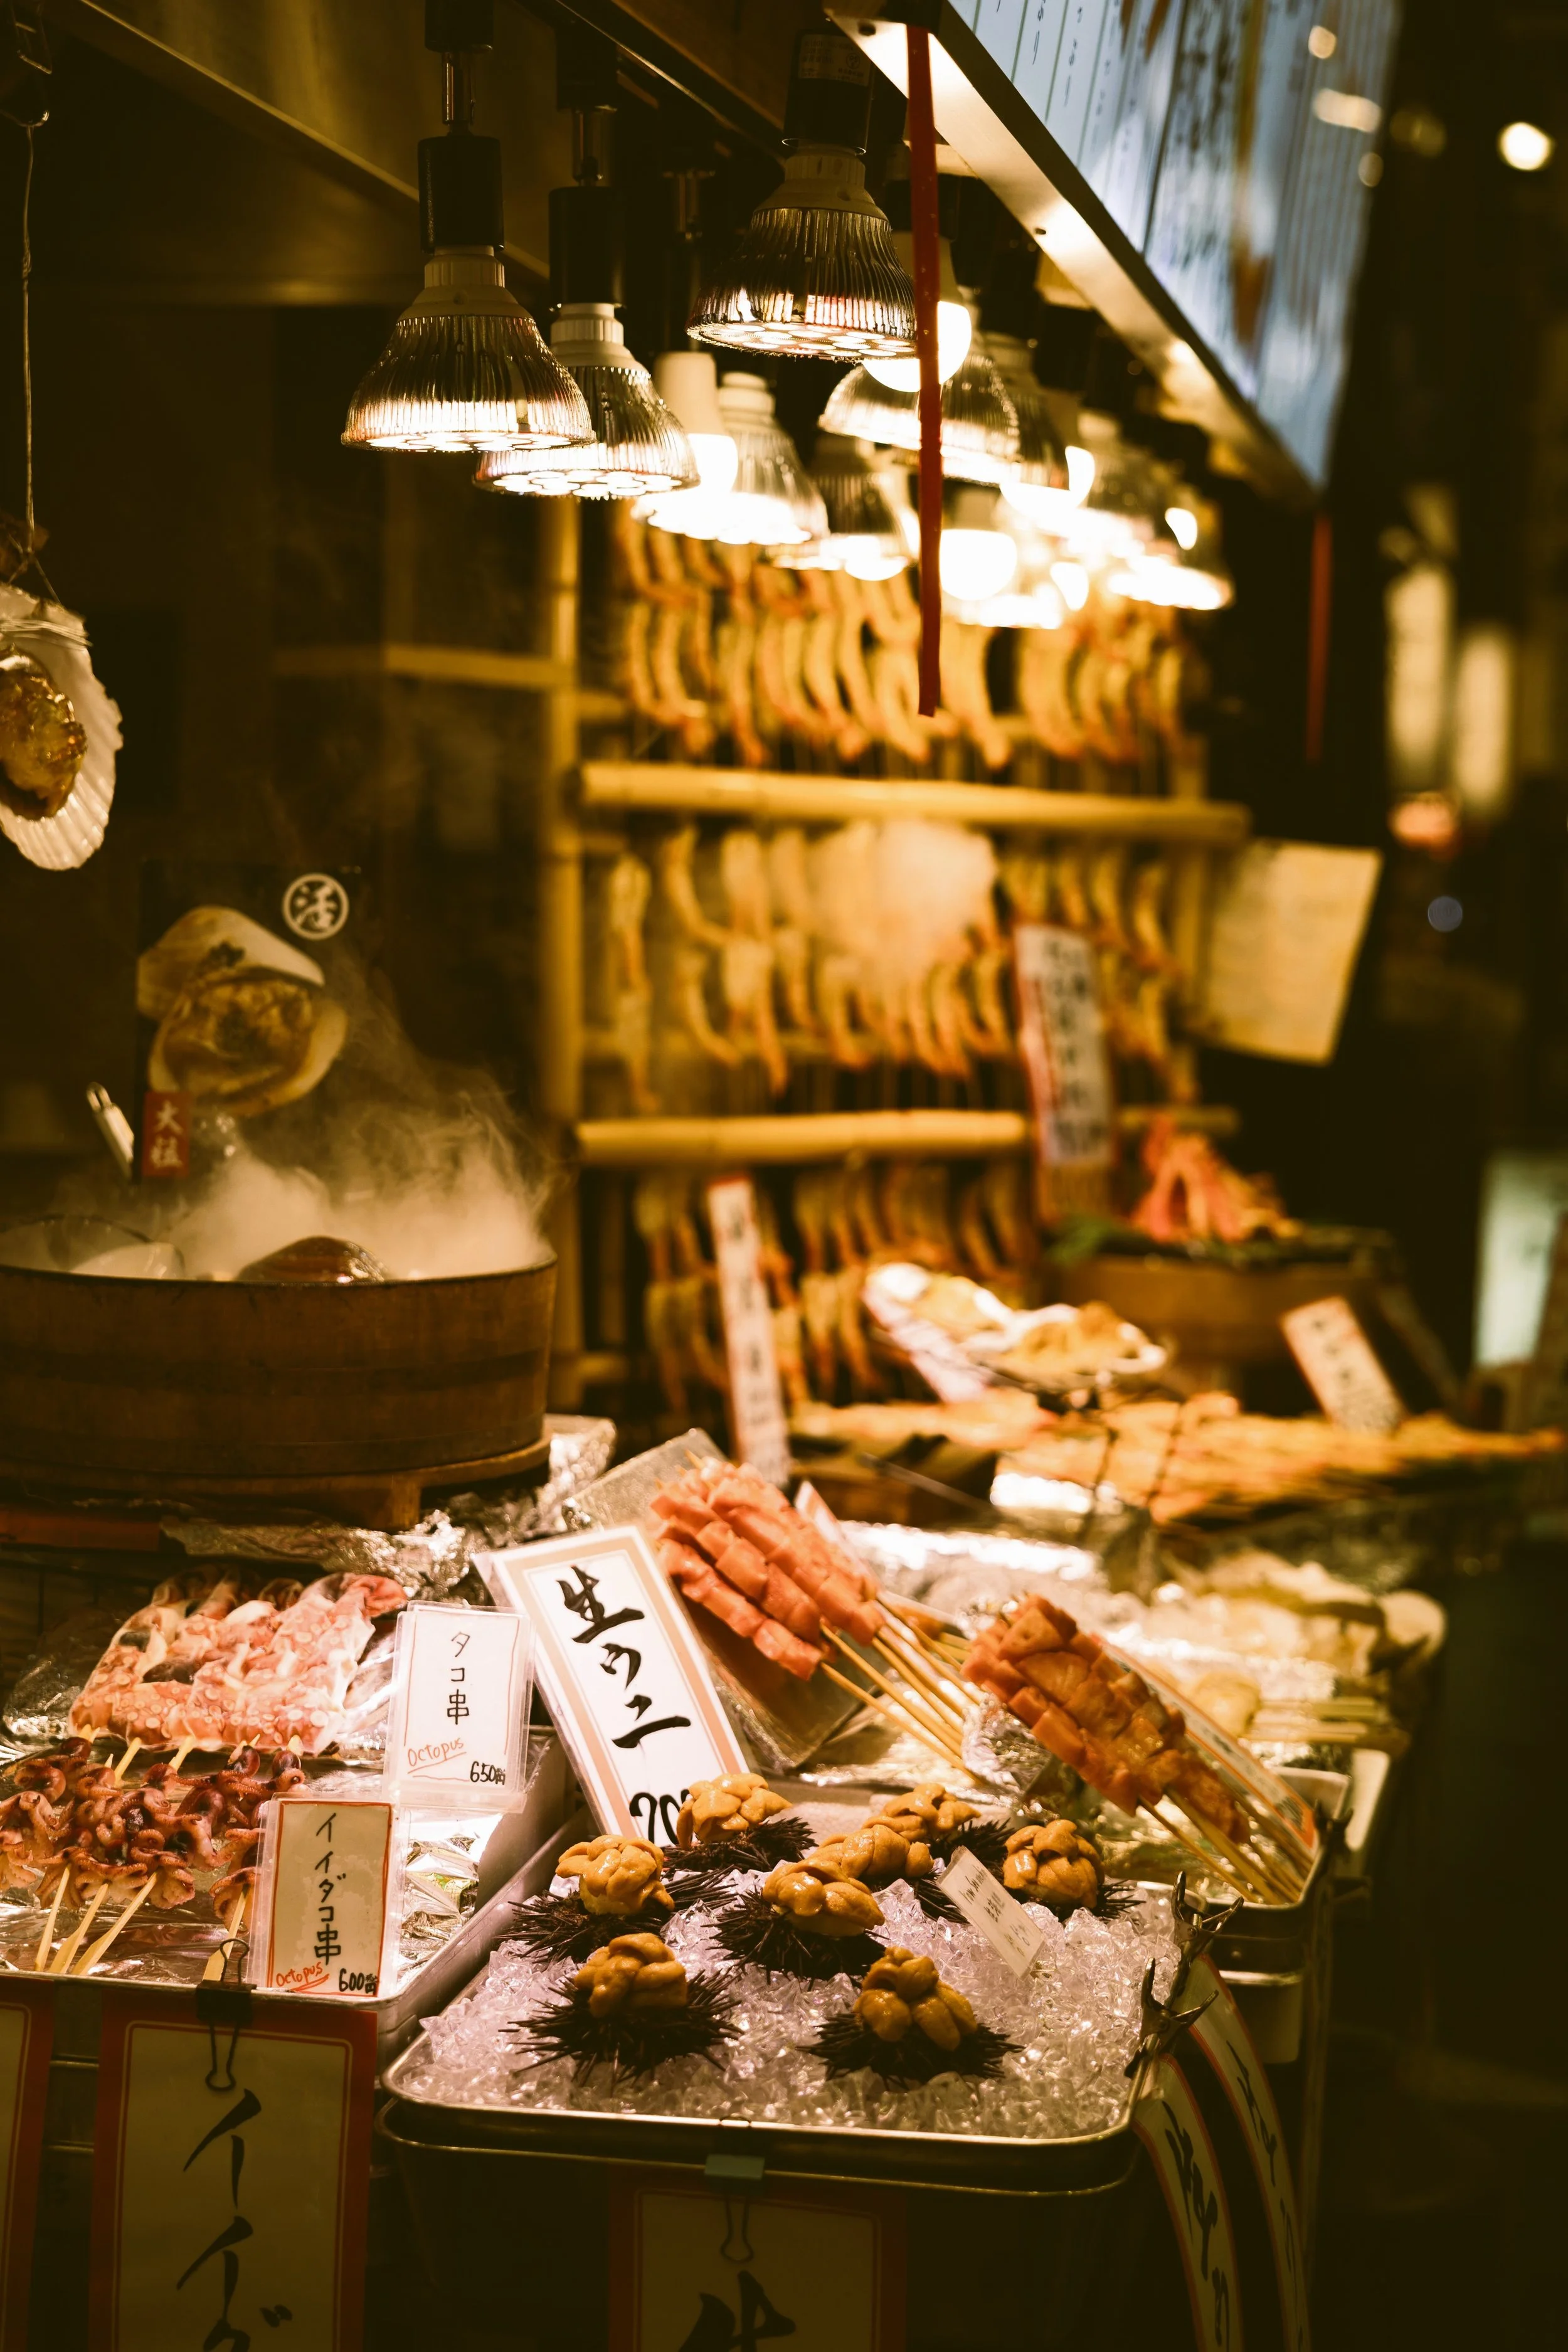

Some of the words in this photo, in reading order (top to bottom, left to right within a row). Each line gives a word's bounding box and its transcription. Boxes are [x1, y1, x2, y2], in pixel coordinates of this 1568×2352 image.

[447, 1631, 470, 1725] タコ串
[556, 1565, 691, 1748] 生ウニ
[315, 1813, 346, 1965] イイダコ串
[276, 1962, 323, 1987] Octopus
